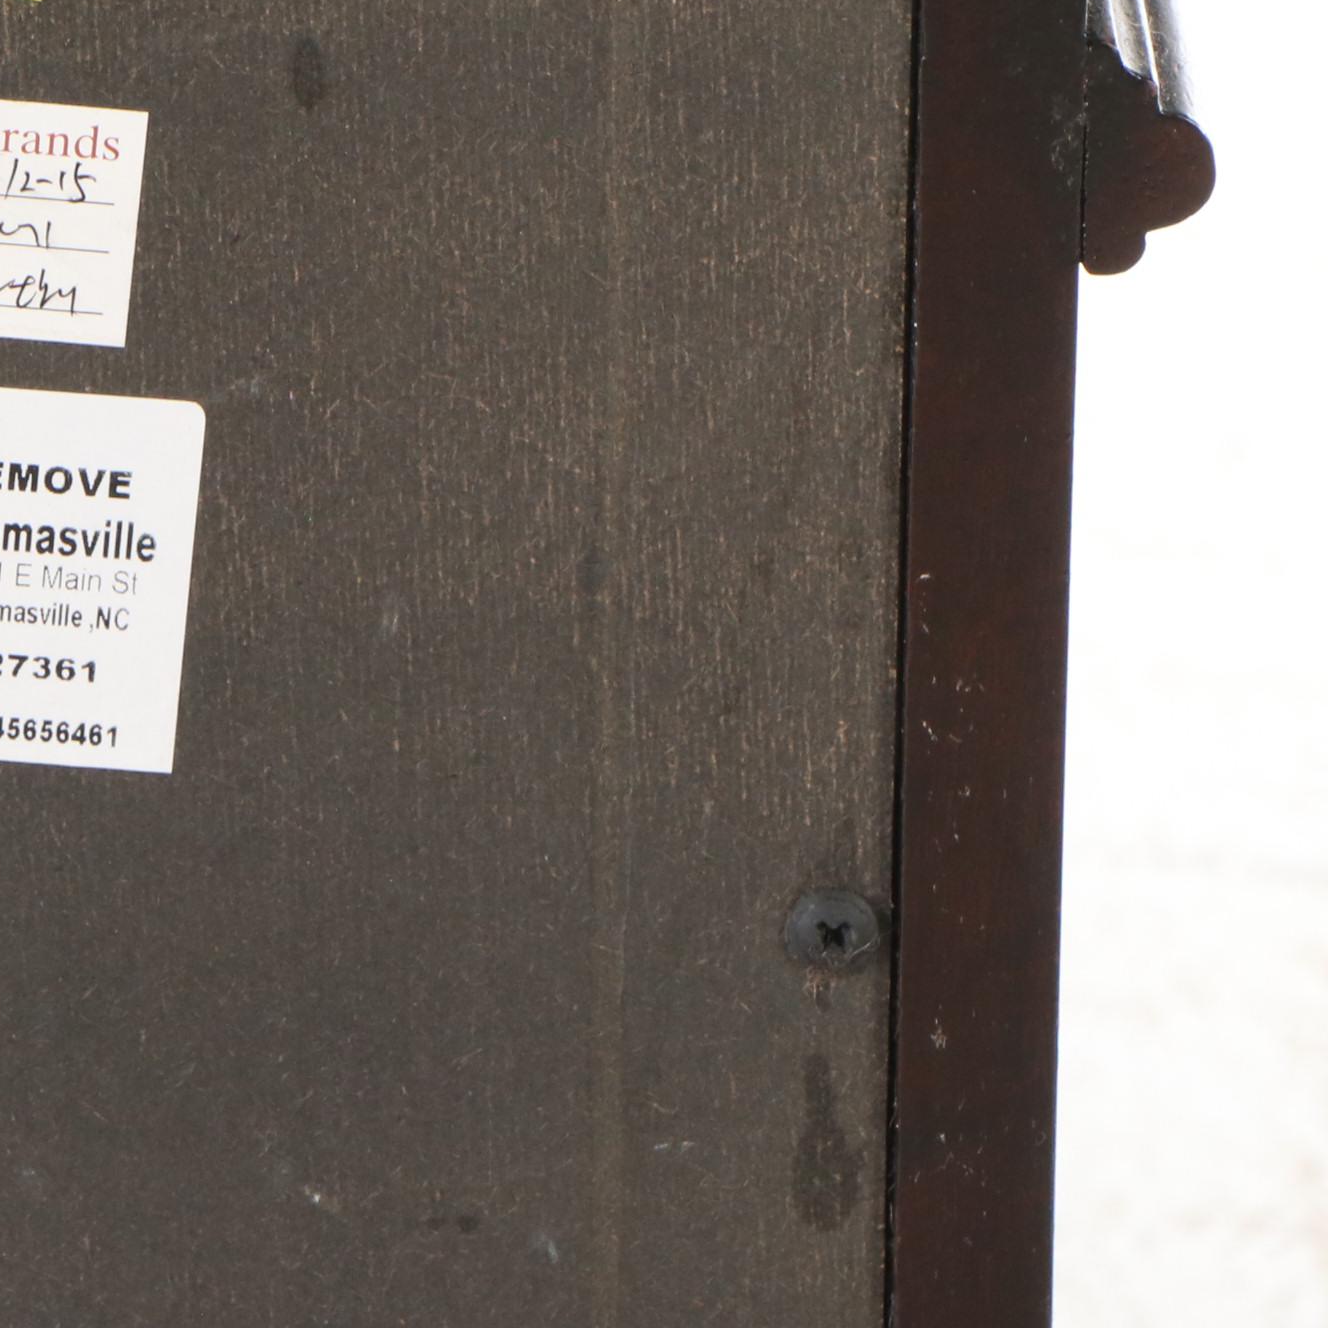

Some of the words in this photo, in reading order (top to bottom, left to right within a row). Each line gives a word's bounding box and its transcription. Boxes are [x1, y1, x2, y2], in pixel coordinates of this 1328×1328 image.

[15, 562, 33, 587] E
[40, 564, 103, 593] Main
[111, 569, 138, 595] St
